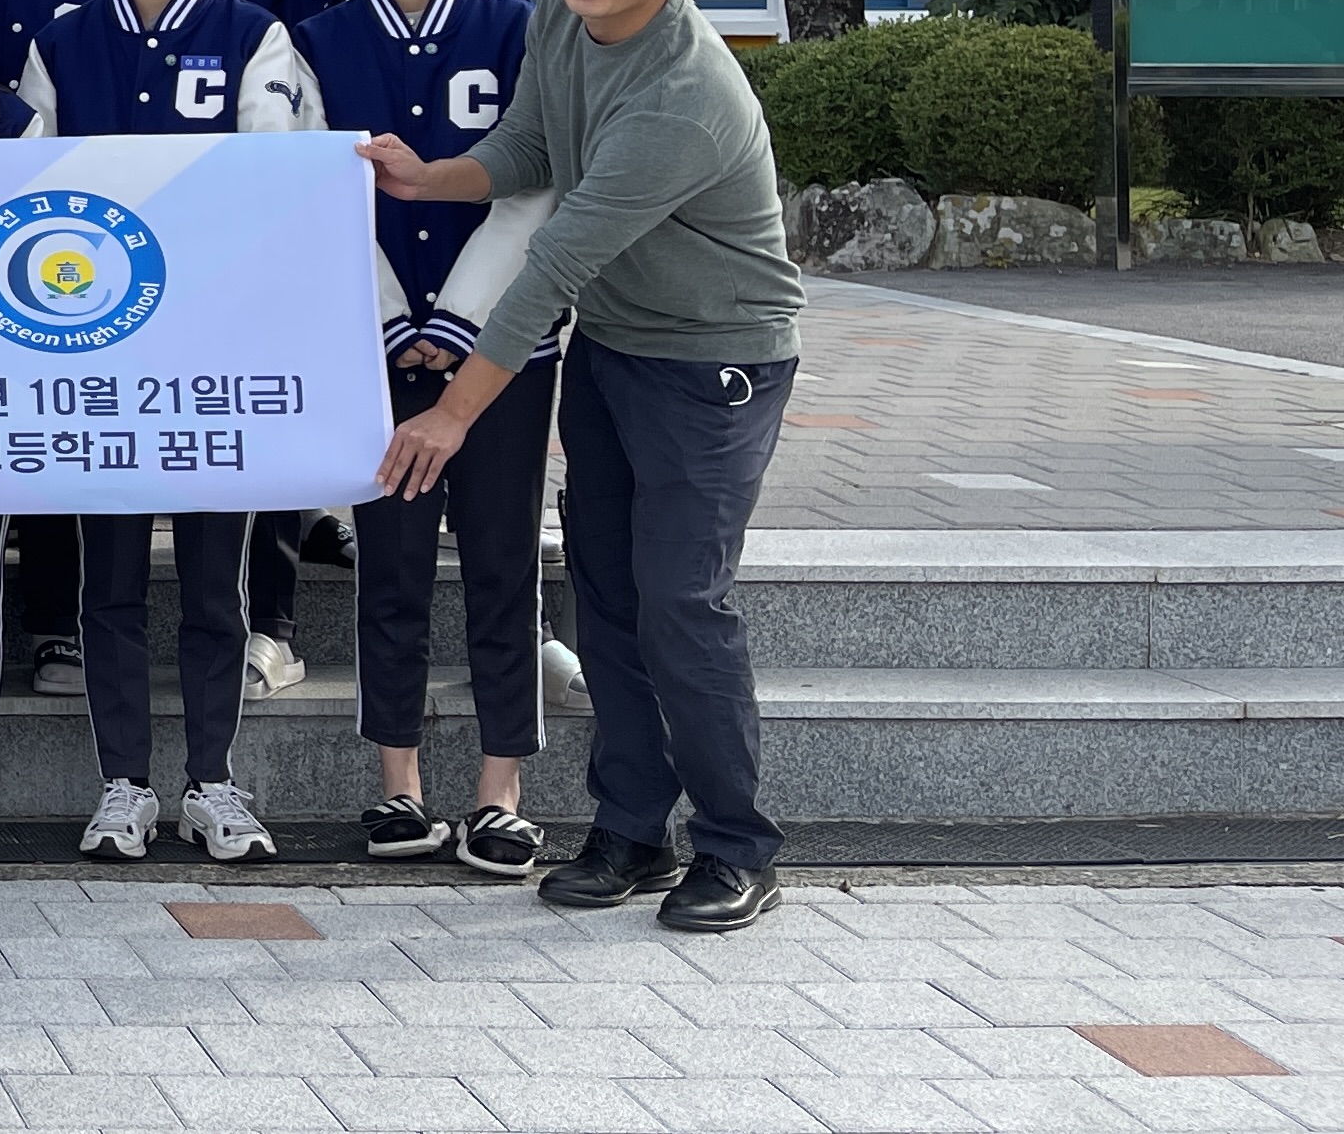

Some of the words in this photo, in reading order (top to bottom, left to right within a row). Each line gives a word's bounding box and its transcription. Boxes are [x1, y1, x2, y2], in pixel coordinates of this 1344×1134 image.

[175, 69, 226, 119] C
[448, 69, 499, 129] C
[65, 324, 119, 347] High
[113, 282, 161, 330] School
[29, 375, 120, 416] 10월
[138, 374, 304, 416] 21일(금)
[157, 429, 245, 471] 꿈터
